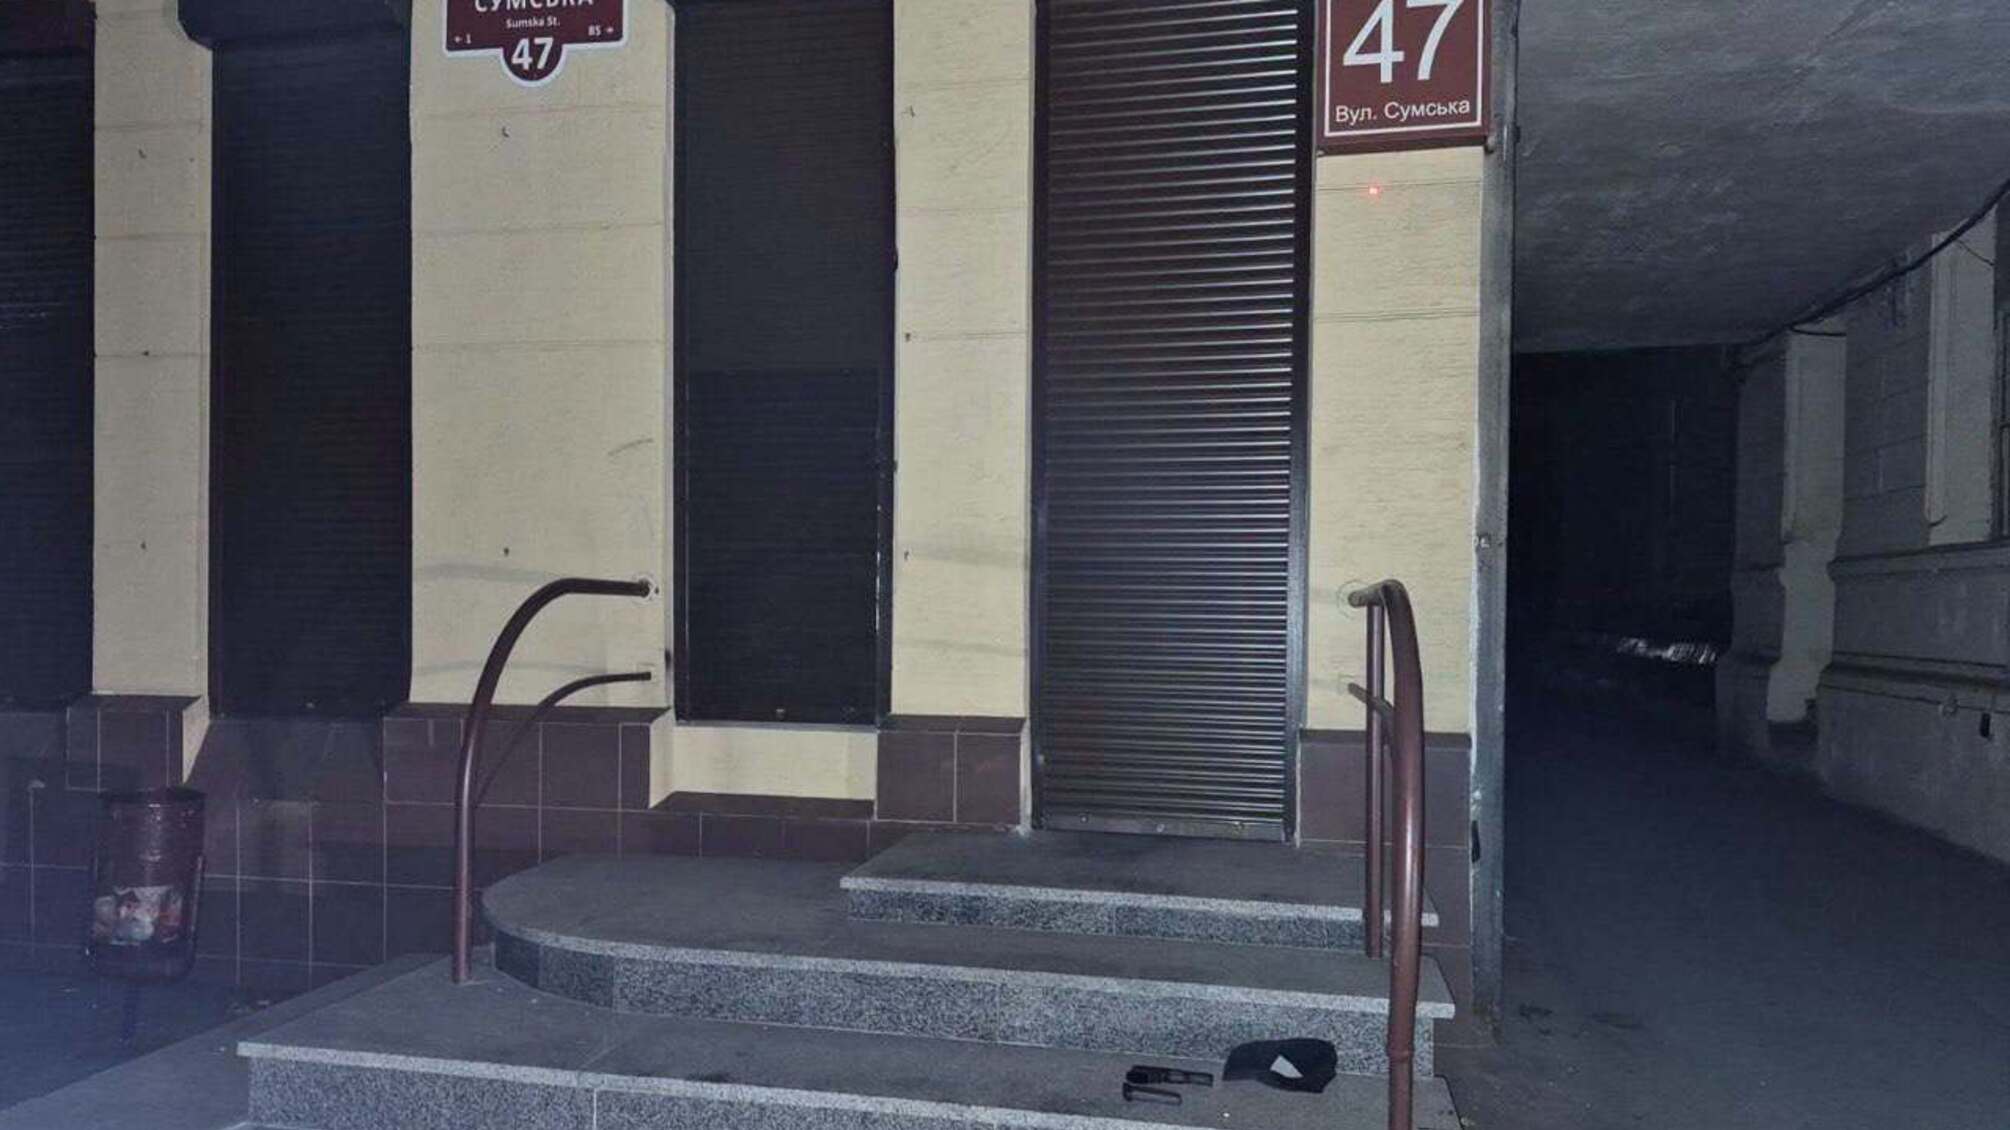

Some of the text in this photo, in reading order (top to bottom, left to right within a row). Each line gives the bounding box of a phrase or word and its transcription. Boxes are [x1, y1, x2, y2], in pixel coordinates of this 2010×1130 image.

[506, 16, 560, 28] Sumska St.
[466, 34, 472, 44] 1
[1342, 0, 1465, 83] 47
[511, 38, 554, 70] 47
[1335, 100, 1471, 125] Вул. Сумська
